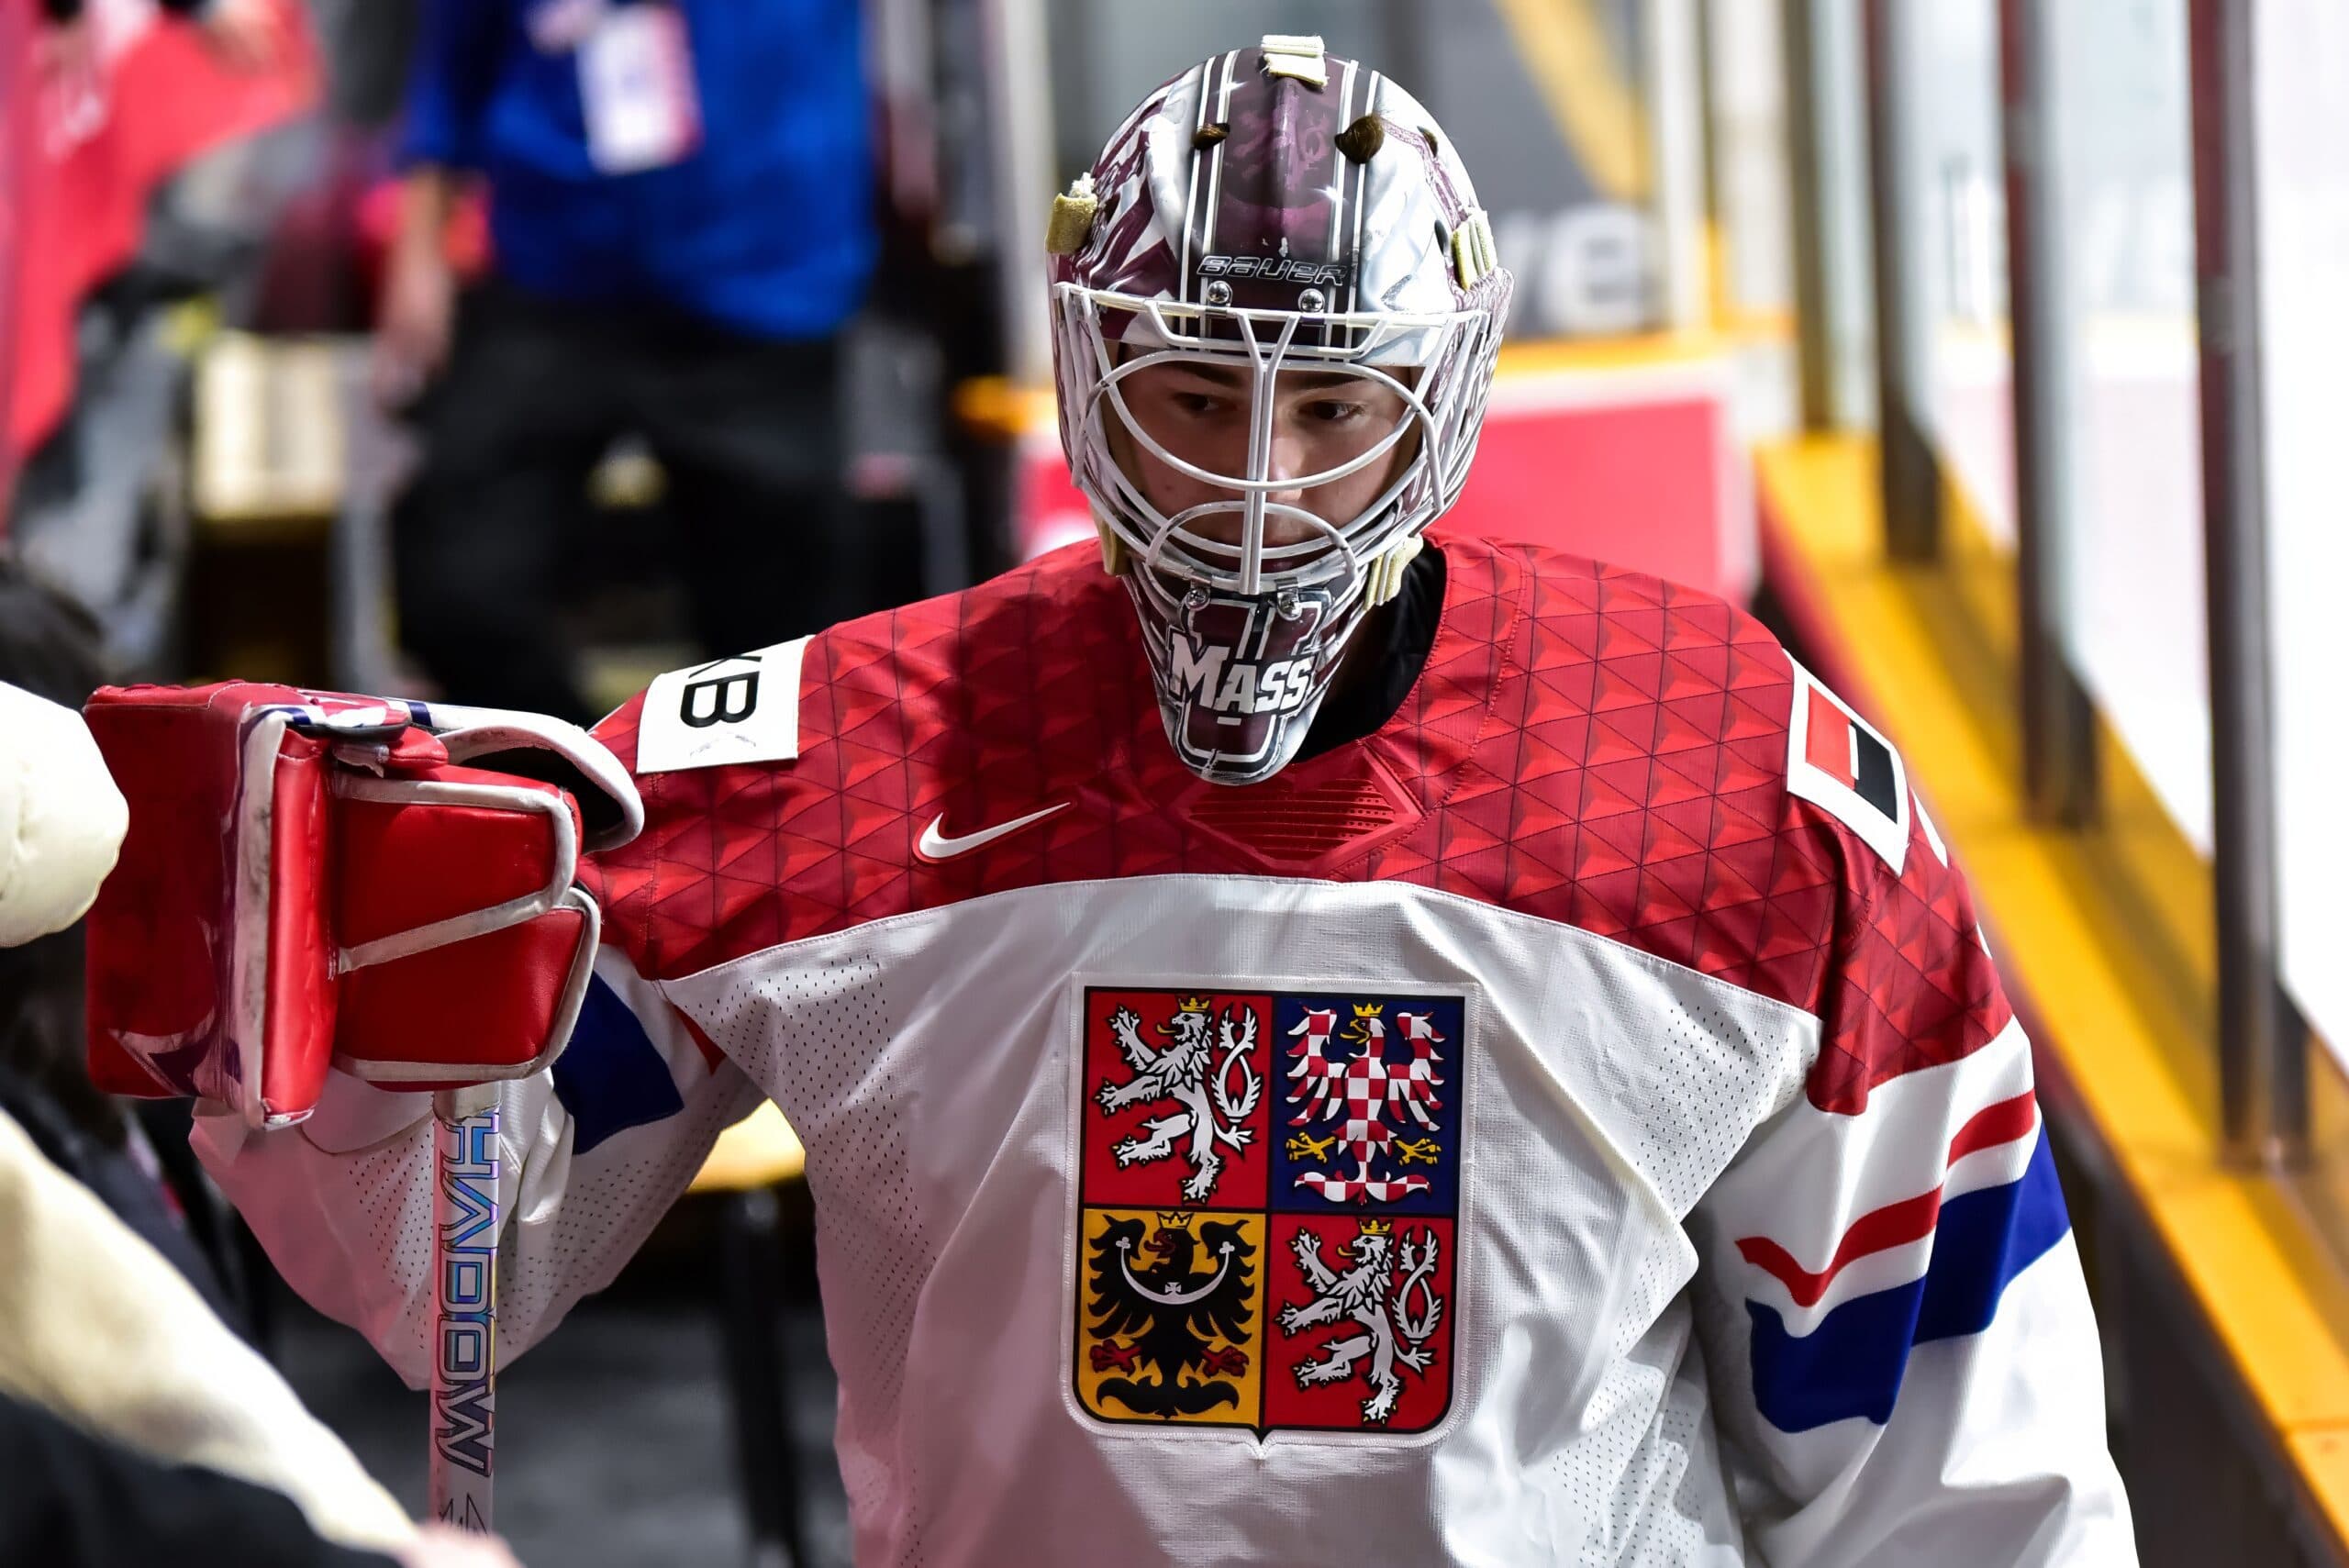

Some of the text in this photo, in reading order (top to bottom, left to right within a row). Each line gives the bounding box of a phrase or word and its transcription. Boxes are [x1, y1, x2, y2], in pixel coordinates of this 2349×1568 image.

[1197, 255, 1347, 286] BAUER
[1171, 631, 1316, 714] MASS
[436, 1108, 500, 1477] HADOW
